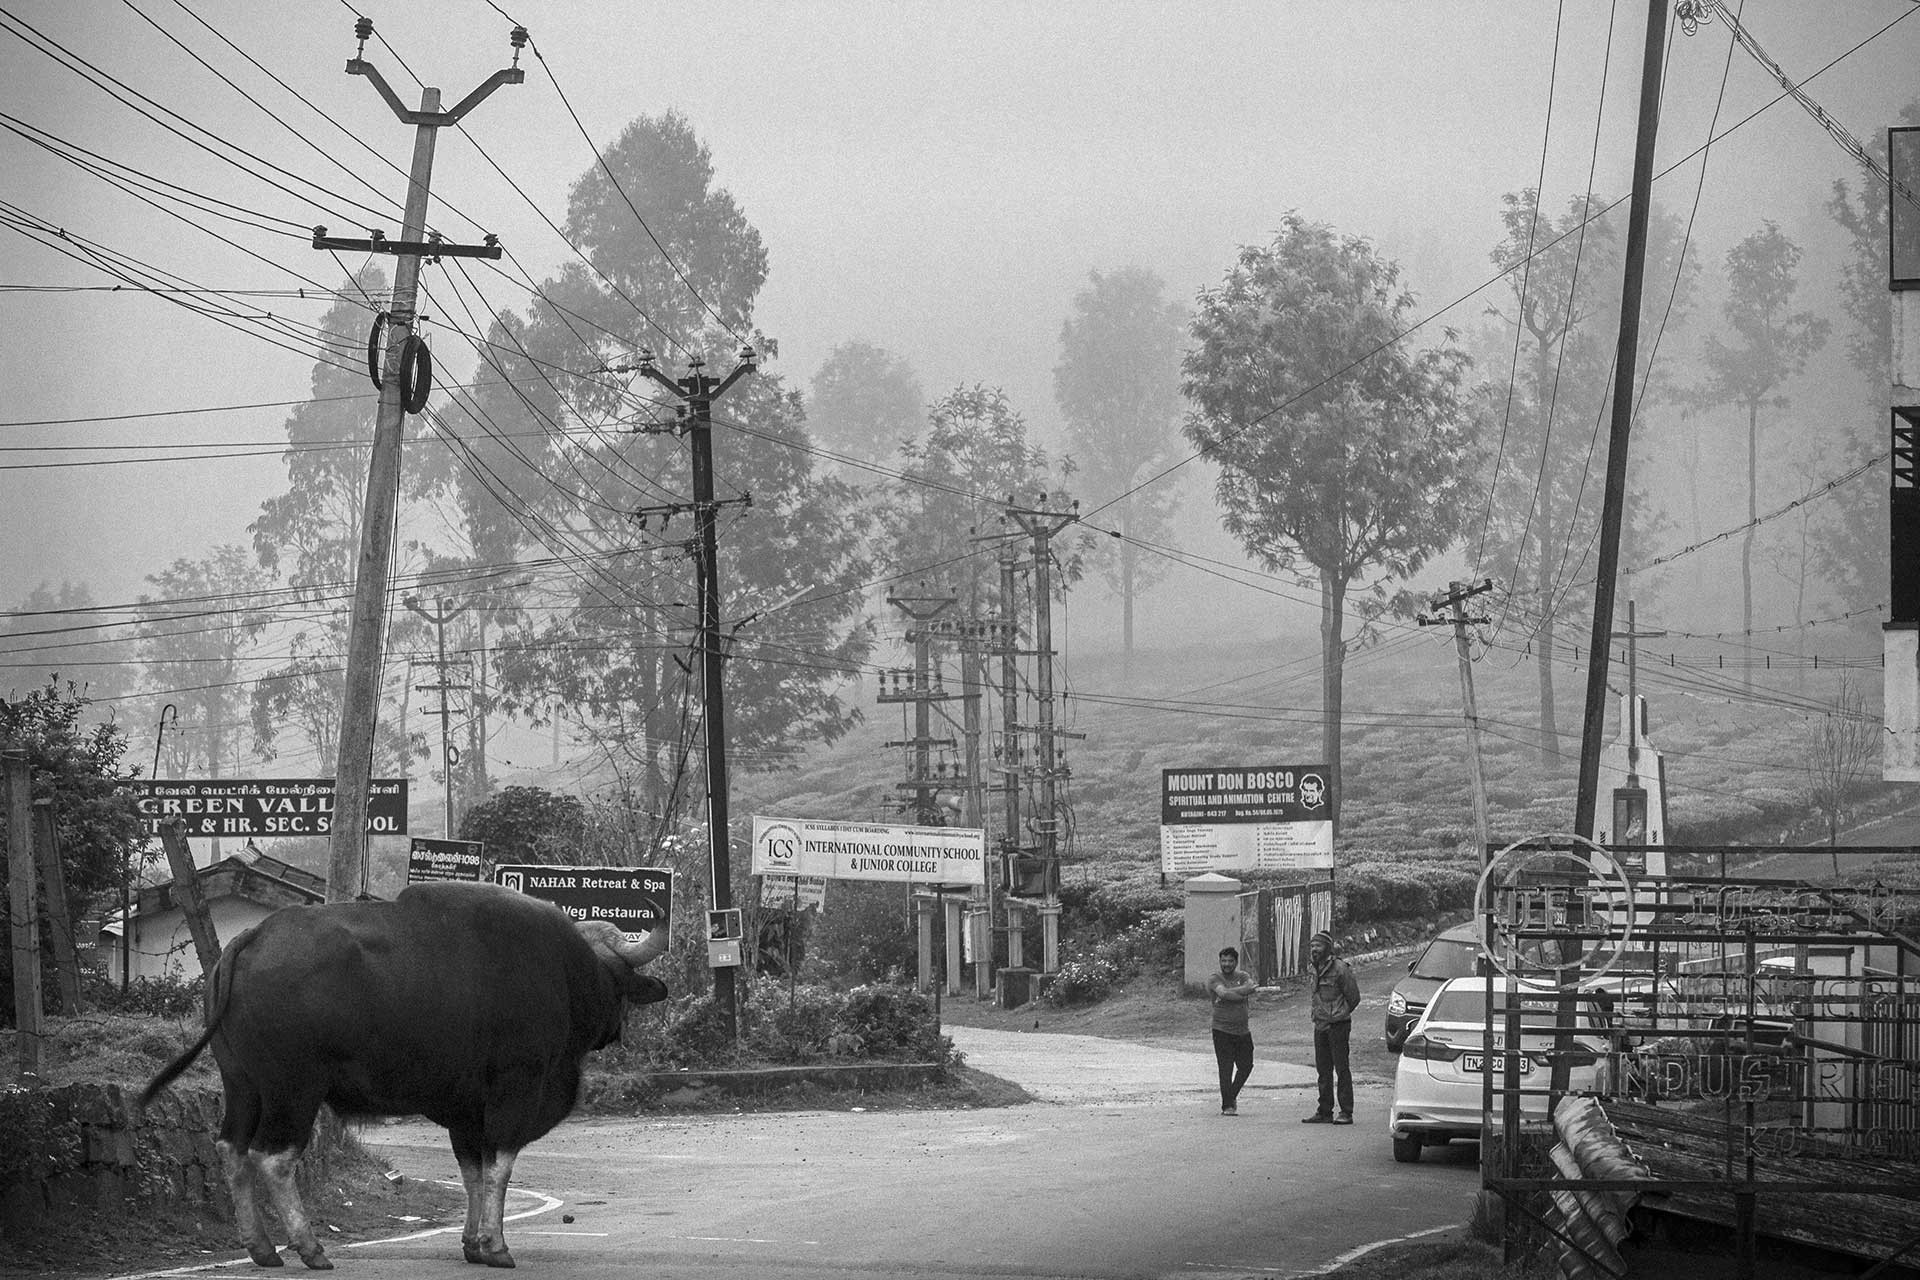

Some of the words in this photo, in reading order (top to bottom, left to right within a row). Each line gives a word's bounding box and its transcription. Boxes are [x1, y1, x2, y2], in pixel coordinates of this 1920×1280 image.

[1168, 774, 1213, 791] MOUNT
[1217, 773, 1244, 790] DON
[1247, 771, 1294, 789] BOSCO
[138, 798, 244, 814] GREEN
[1169, 795, 1206, 806] SPIRITUAL
[1208, 794, 1222, 805] AND
[1223, 793, 1264, 805] ANIMATION
[1267, 792, 1294, 804] CENTRE
[200, 818, 217, 833] &
[223, 817, 258, 833] HR.
[265, 816, 310, 833] SEC.
[768, 839, 793, 859] ICS
[805, 840, 882, 856] INTERNATIONAL
[883, 844, 942, 859] COMMUNITY
[943, 847, 980, 860] SCHOOL
[850, 858, 858, 870] &
[860, 858, 895, 872] JUNIOR
[896, 859, 938, 873] COLLEGE
[530, 877, 576, 888] NAHAR
[582, 877, 627, 889] Retreat
[631, 878, 640, 890] &
[644, 879, 666, 893] Spa
[562, 905, 587, 919] Veg
[592, 906, 654, 919] Restaura
